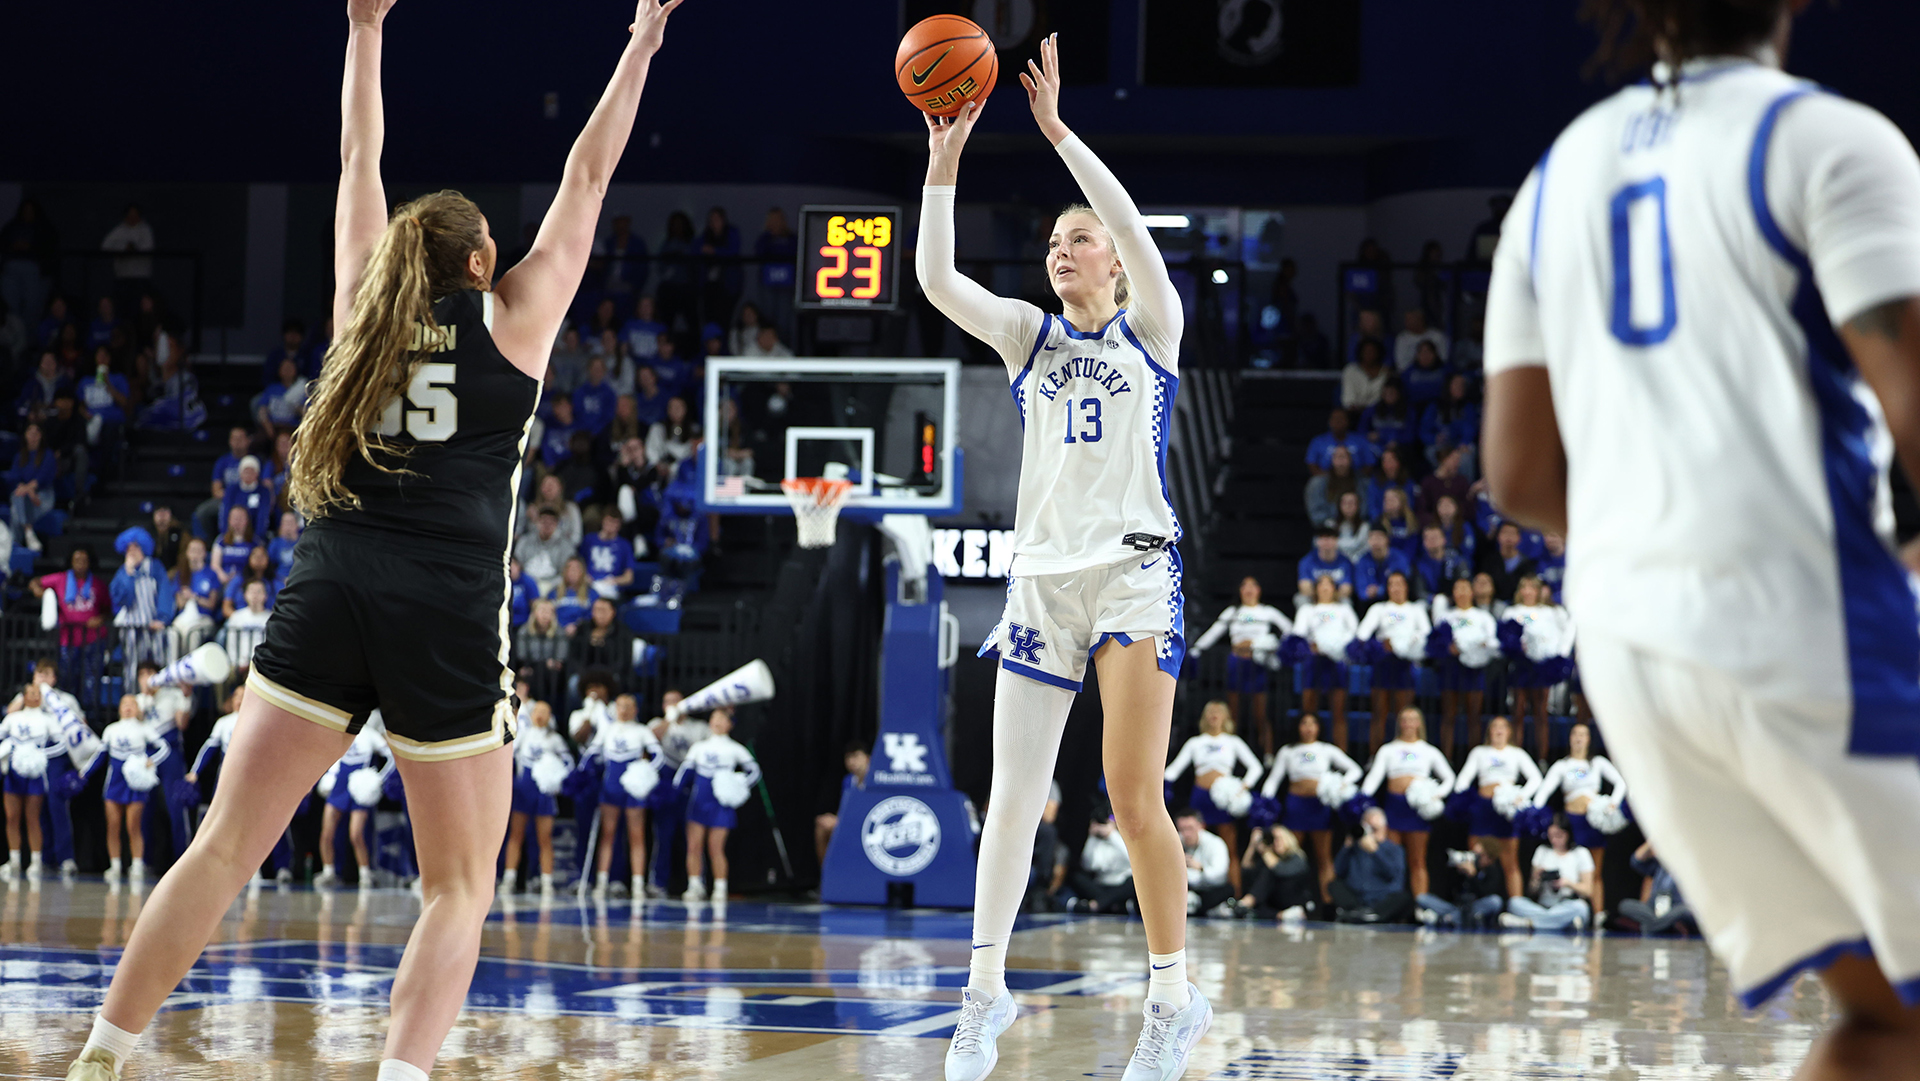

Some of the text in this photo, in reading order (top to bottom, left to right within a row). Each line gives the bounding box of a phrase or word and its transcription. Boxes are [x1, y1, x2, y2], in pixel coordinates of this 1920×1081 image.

[925, 76, 977, 109] ELITE
[827, 216, 891, 247] 6:43
[816, 246, 882, 298] 23
[1610, 176, 1678, 347] 0
[1039, 357, 1131, 401] KENTUCKY
[1064, 397, 1102, 443] 13
[1009, 622, 1045, 665] UK
[882, 732, 928, 771] UK
